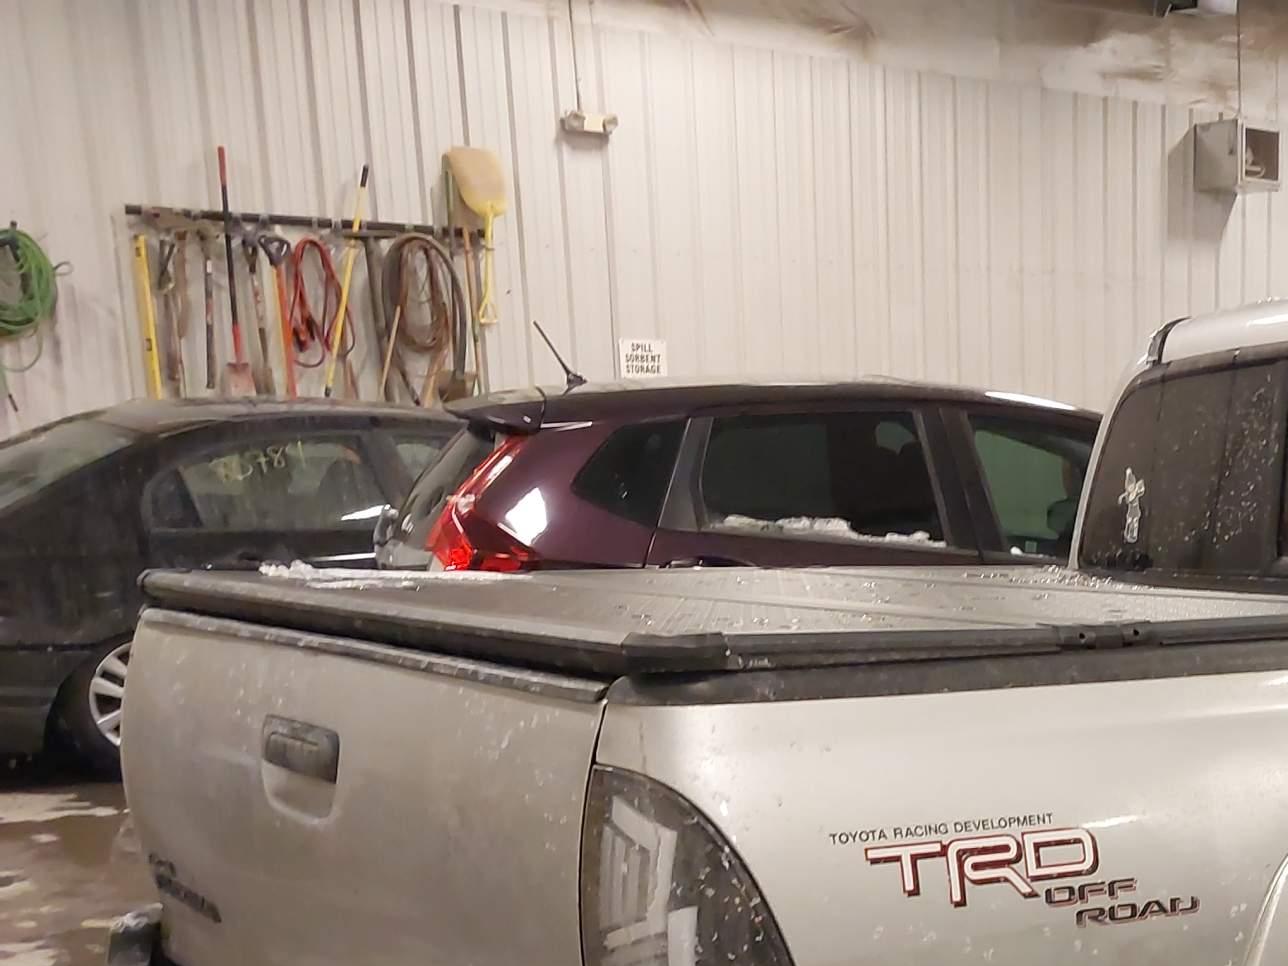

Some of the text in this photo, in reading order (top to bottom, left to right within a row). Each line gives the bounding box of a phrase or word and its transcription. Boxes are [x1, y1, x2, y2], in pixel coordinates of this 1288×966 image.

[625, 353, 661, 364] SORBENT
[631, 342, 653, 353] SPILL
[626, 364, 661, 374] STORAGE
[828, 812, 1054, 846] TOYOTA RACING DEVELOPMENT
[864, 827, 1100, 908] TRD
[1044, 877, 1139, 909] OFF
[1074, 895, 1201, 928] ROAD
